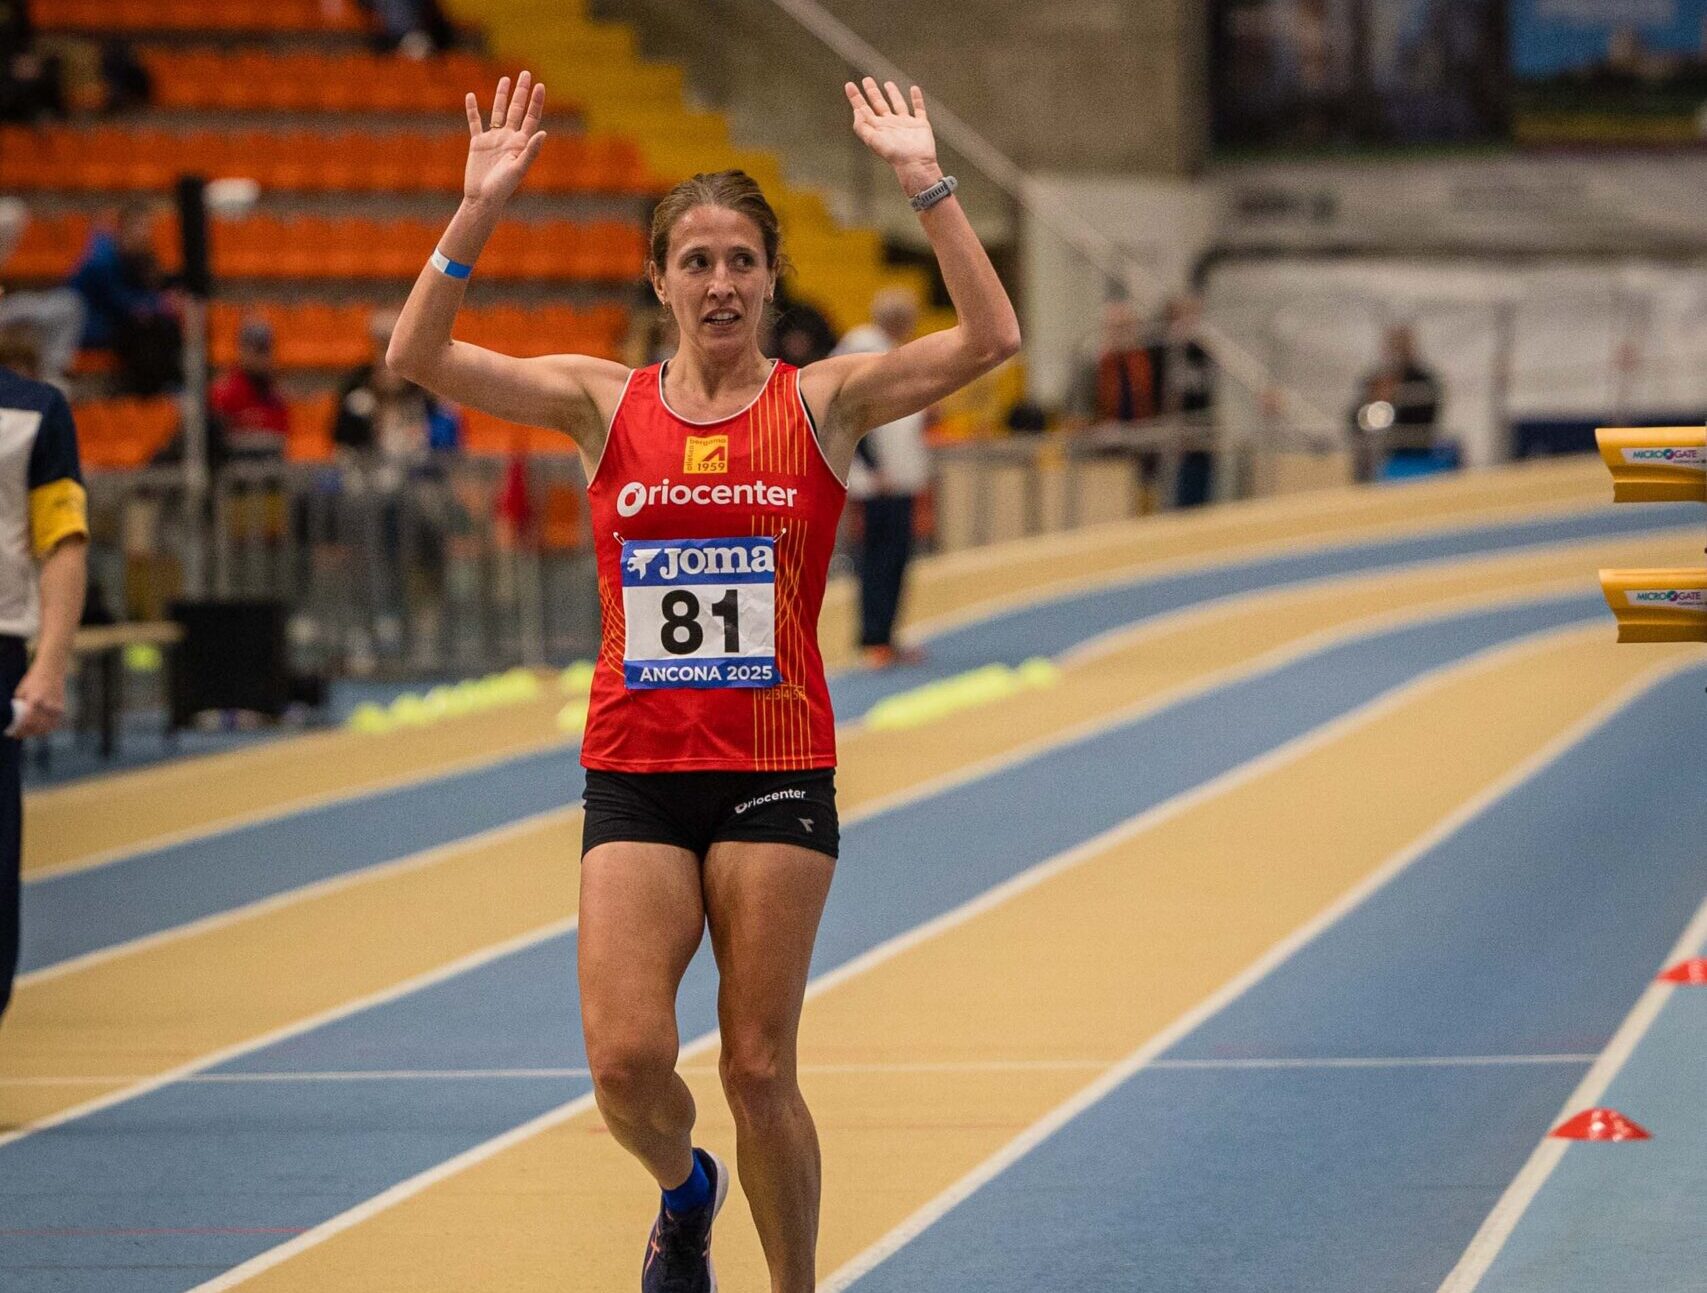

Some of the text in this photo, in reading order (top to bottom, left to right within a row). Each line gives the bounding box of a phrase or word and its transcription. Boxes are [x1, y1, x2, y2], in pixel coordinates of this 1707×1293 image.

[697, 462, 725, 472] 1959
[616, 478, 798, 517] Oriocenter
[660, 589, 740, 655] 81
[640, 665, 773, 682] ANCONA 2025
[734, 788, 806, 814] Oriocenter
